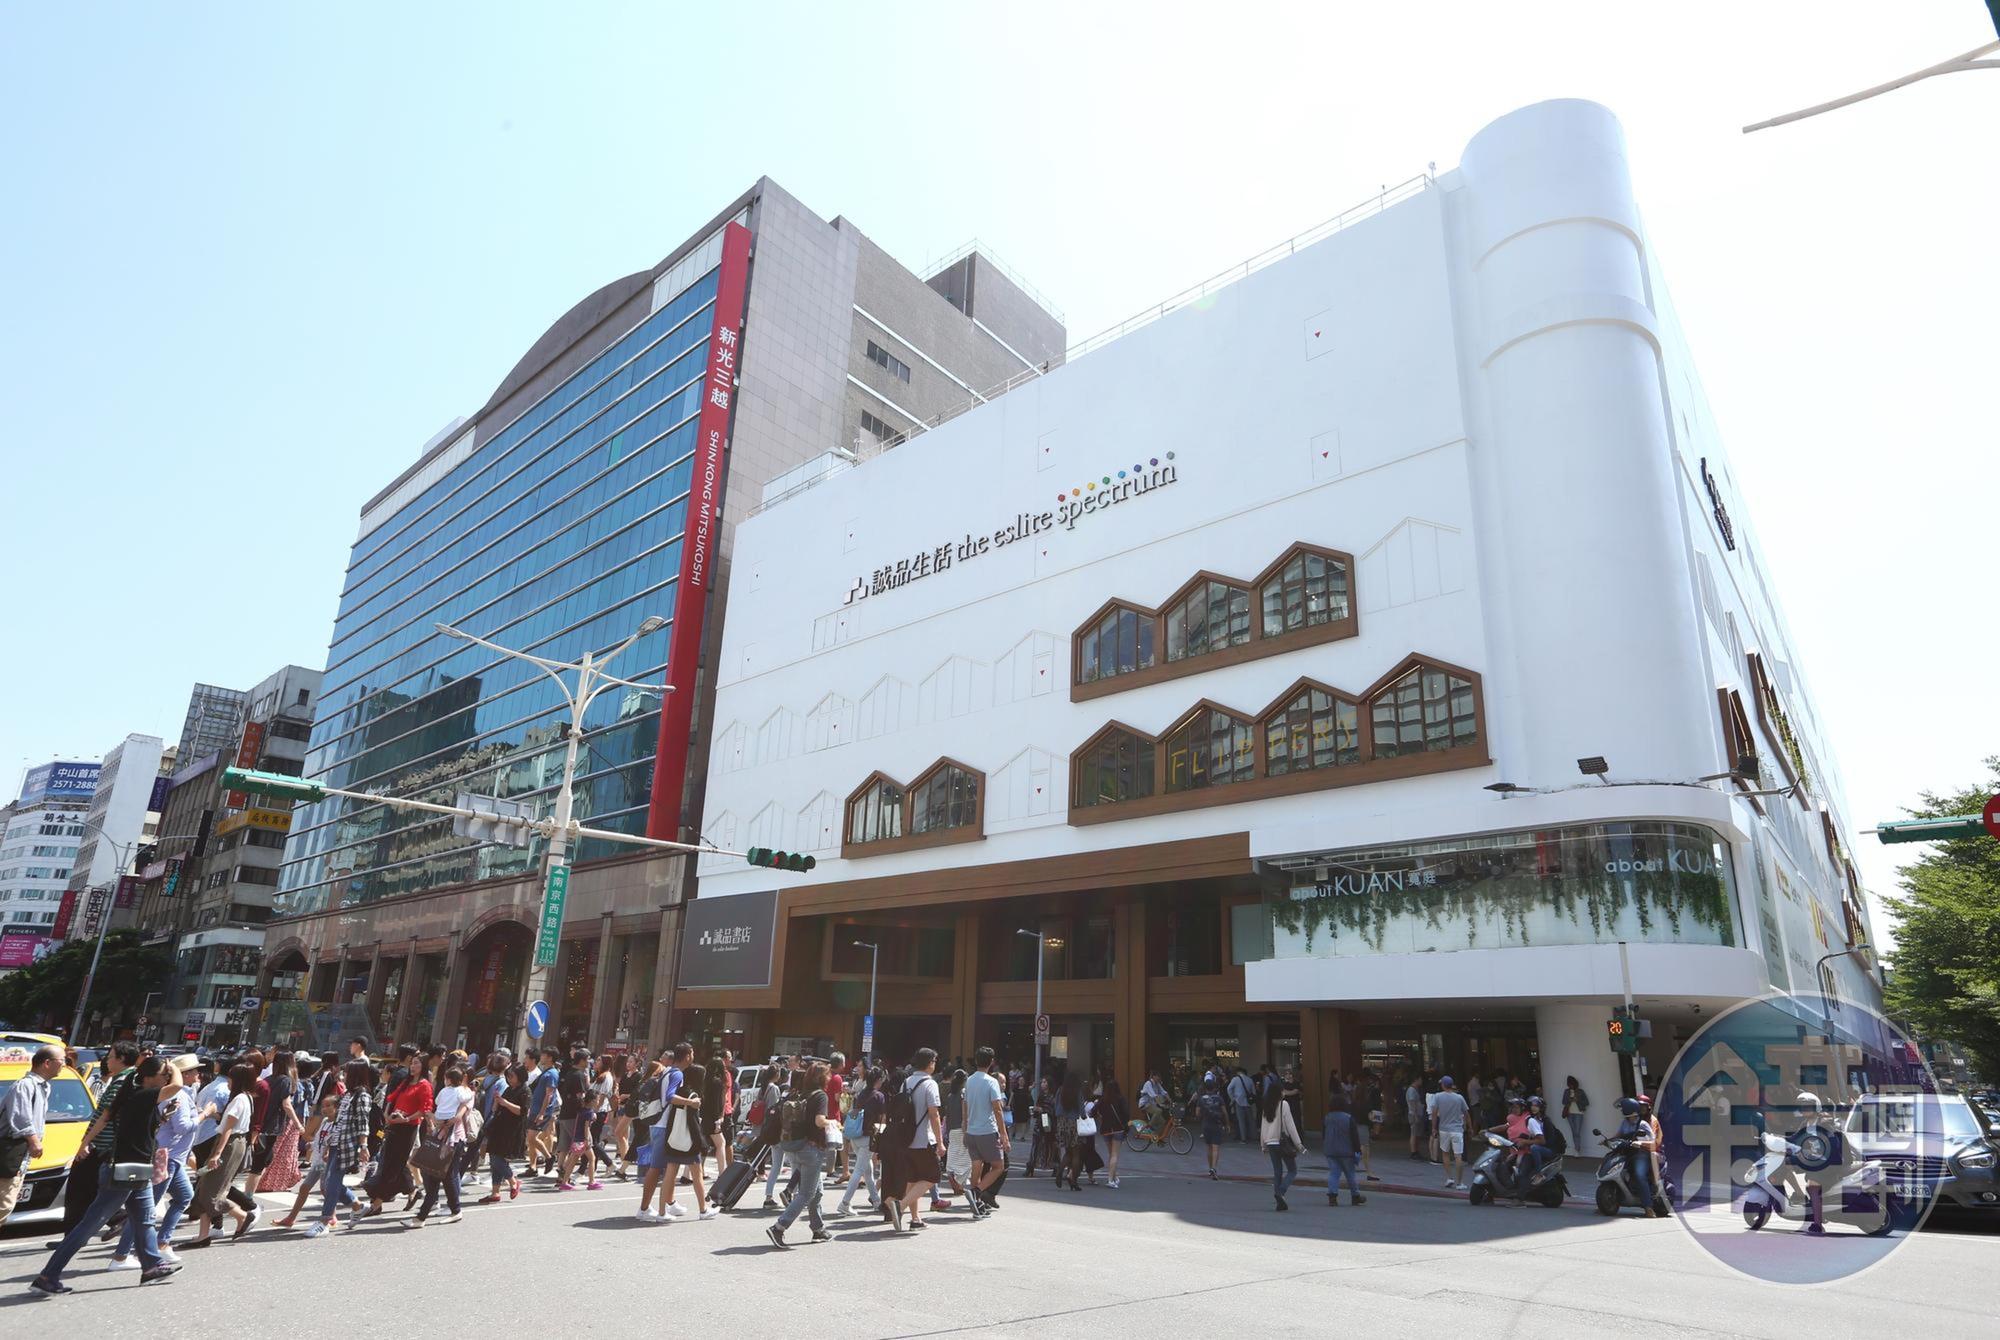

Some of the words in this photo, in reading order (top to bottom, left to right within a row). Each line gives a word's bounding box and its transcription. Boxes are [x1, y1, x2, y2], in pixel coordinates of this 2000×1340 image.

[711, 326, 736, 410] 新光三越
[691, 502, 710, 585] MITSUKOSHI
[871, 542, 952, 596] 誠品生活
[957, 533, 989, 562] the
[993, 512, 1053, 548] eslite
[1058, 463, 1177, 530] spectrum
[52, 780, 98, 789] 2571-2888
[58, 767, 99, 779] 中山首席
[1605, 858, 1663, 873] about
[1668, 848, 1716, 877] KUA
[1334, 870, 1404, 897] KUAN
[546, 877, 563, 928] 南京西路
[713, 926, 752, 944] 誠品書店
[1609, 1022, 1623, 1034] 20
